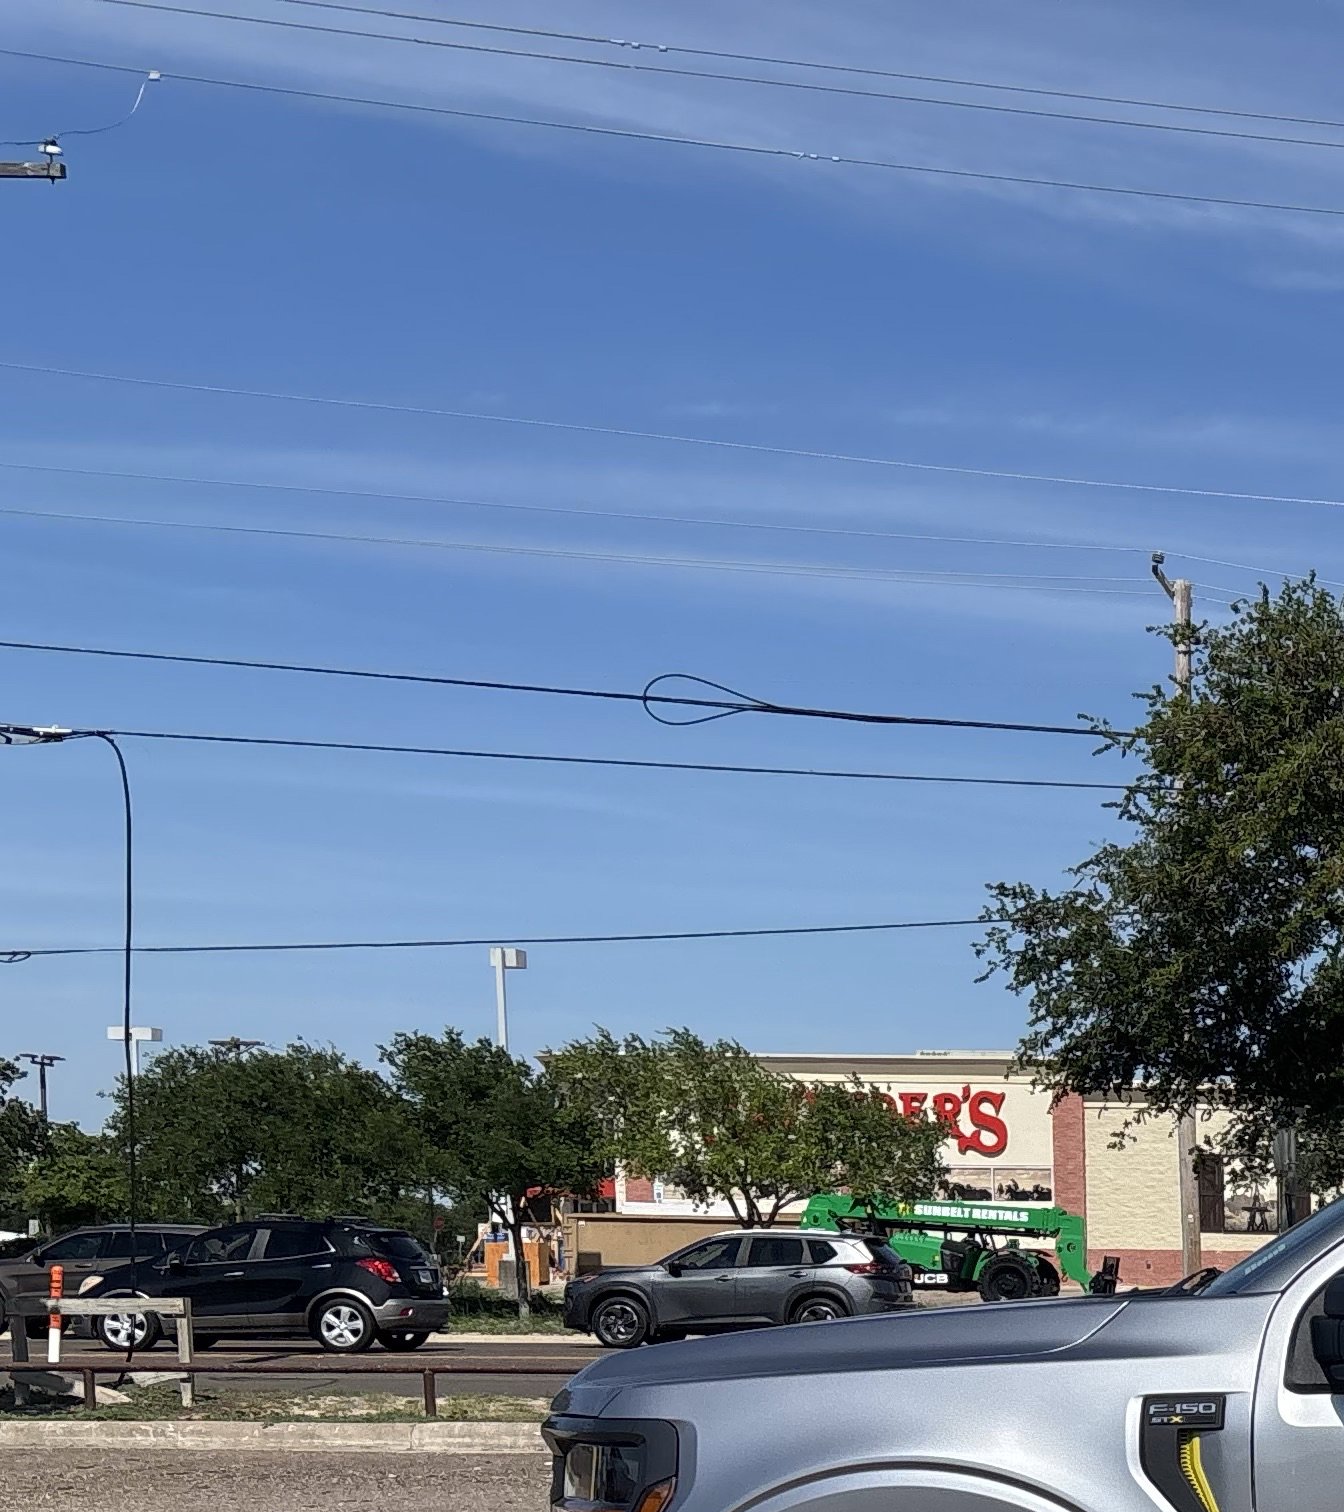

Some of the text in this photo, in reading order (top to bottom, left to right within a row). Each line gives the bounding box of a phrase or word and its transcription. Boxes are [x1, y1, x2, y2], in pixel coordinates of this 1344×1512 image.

[914, 1204, 1029, 1222] SUNBELT RENTALS
[914, 1273, 949, 1284] JCB
[1148, 1402, 1217, 1415] F-150
[1151, 1416, 1183, 1424] STX
